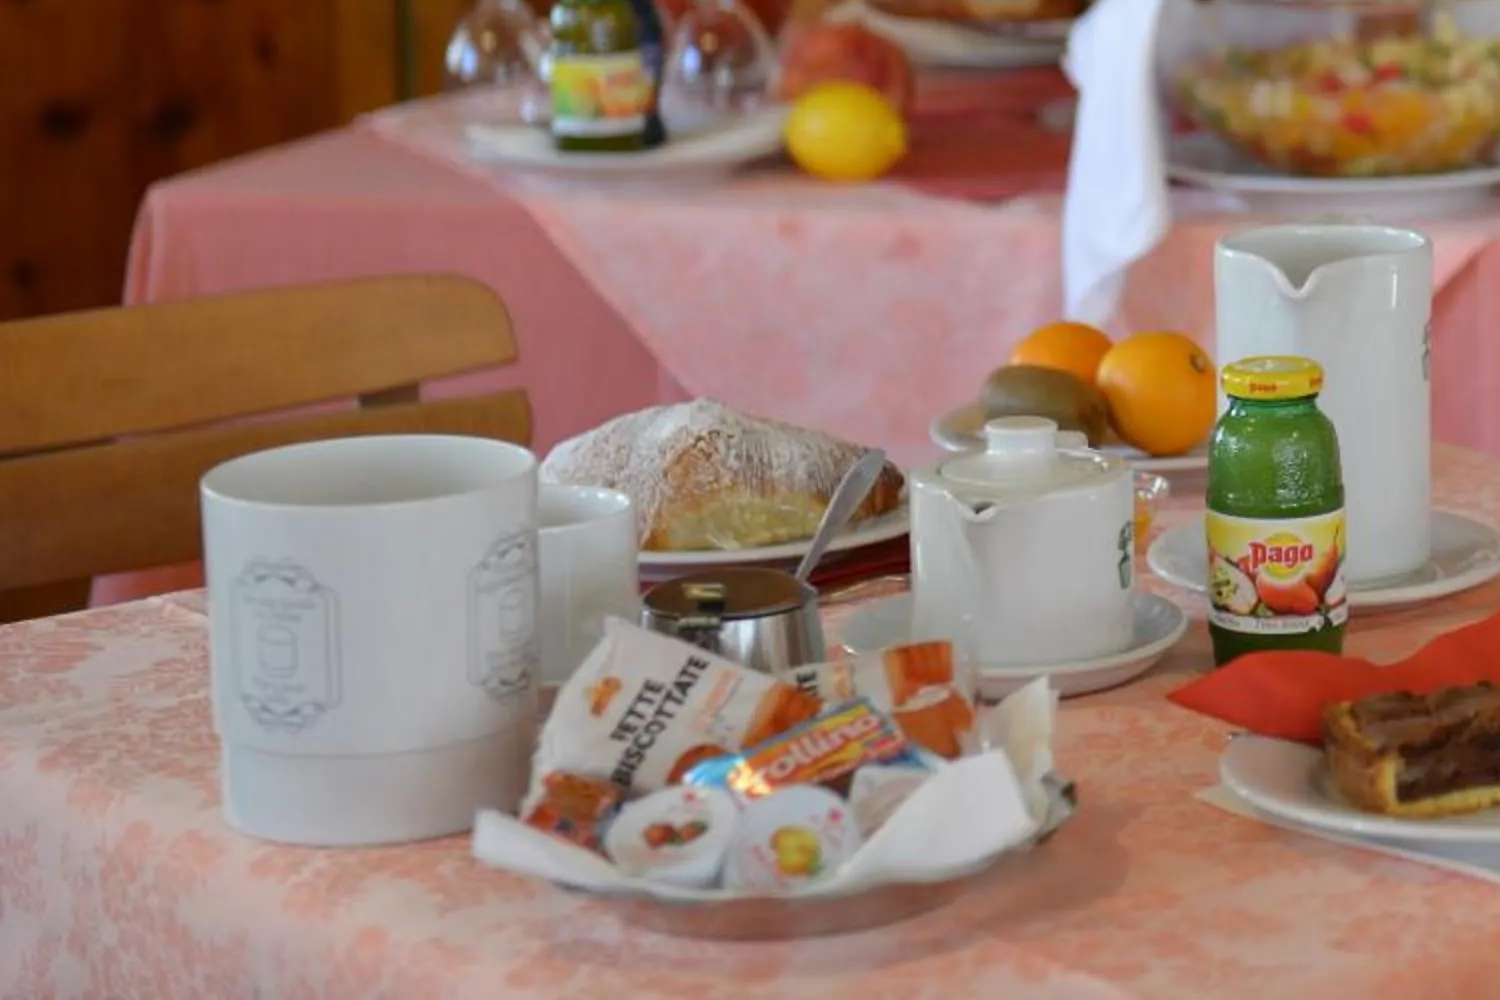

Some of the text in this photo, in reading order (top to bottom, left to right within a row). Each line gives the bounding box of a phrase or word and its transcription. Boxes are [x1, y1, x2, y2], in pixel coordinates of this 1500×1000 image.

[1248, 541, 1313, 569] pago
[608, 678, 666, 742] FETTE
[610, 654, 711, 787] BISCOTTATE
